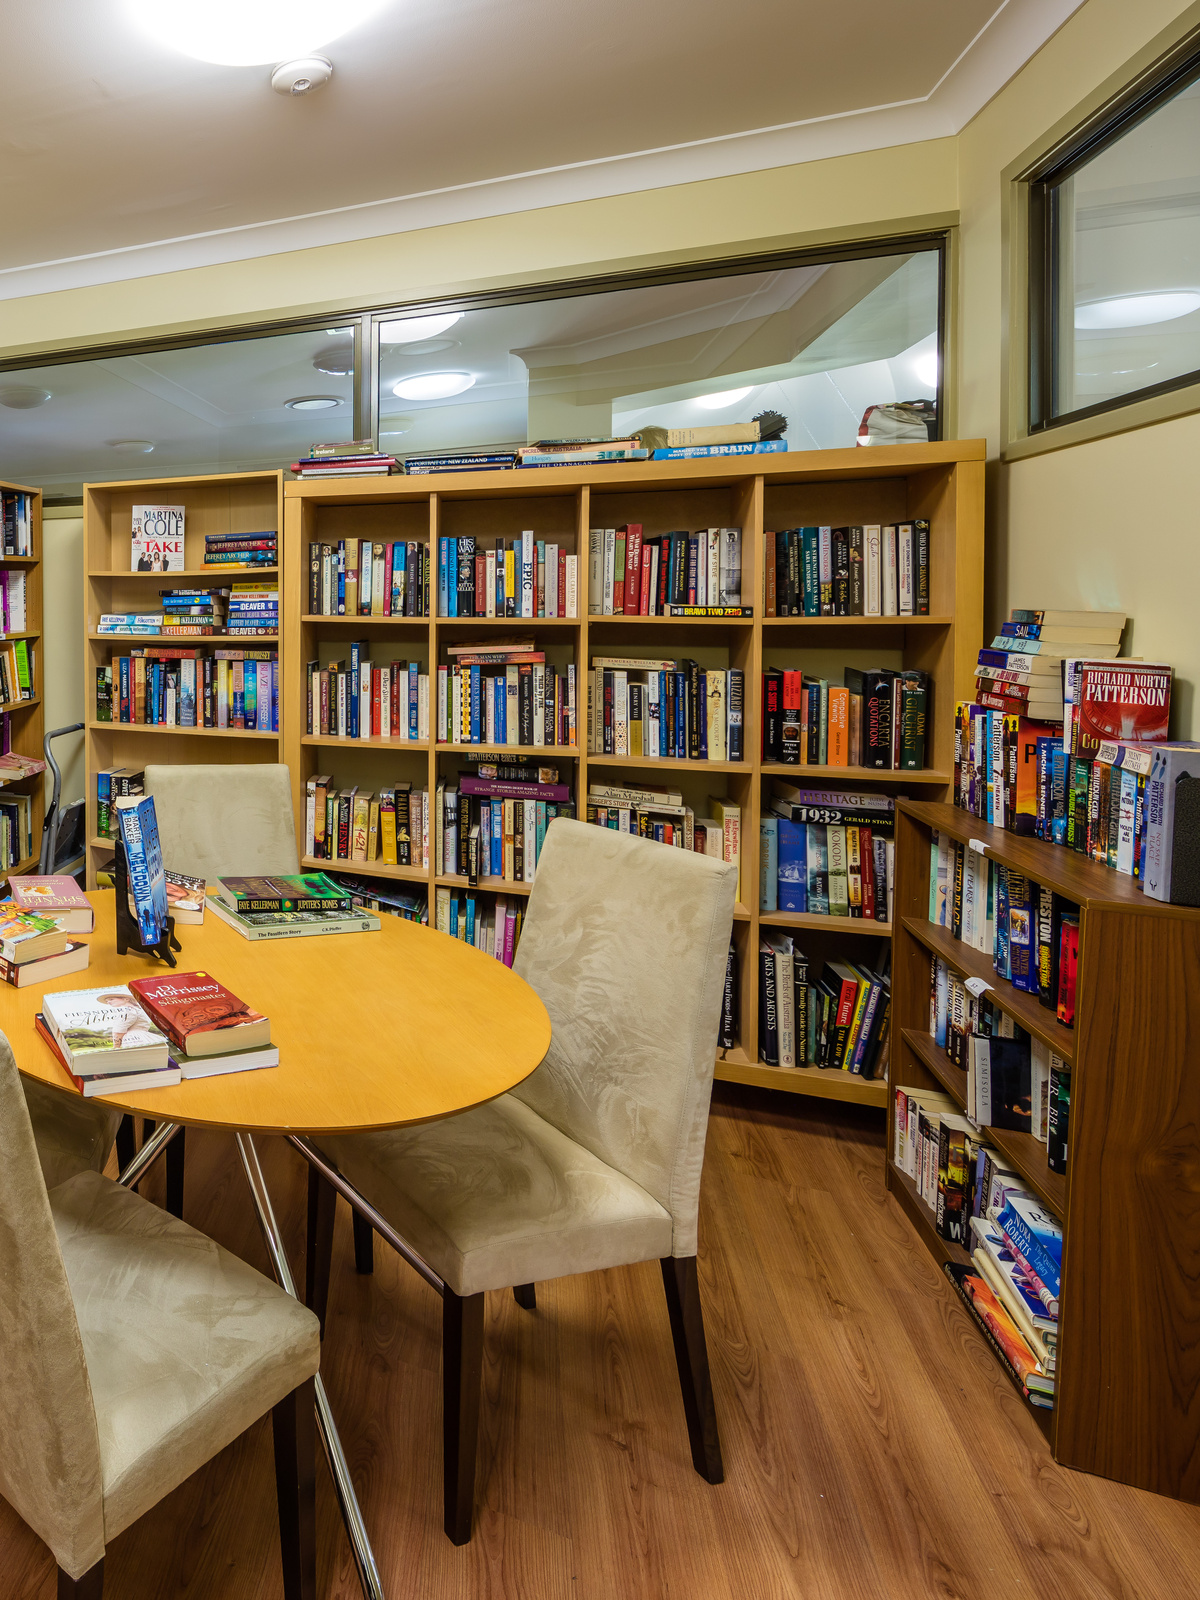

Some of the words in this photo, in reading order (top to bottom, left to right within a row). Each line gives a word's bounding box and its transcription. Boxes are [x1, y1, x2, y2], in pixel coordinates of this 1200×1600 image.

[710, 443, 753, 455] BRAIN
[144, 511, 183, 521] MARTINA
[144, 520, 183, 536] COLE
[822, 528, 830, 546] SARA
[146, 541, 183, 553] TAKE
[458, 545, 474, 553] WAY
[459, 537, 474, 546] HIS
[822, 548, 830, 579] HENDERSON
[523, 562, 532, 590] EPIC
[241, 602, 265, 610] DEAVER
[183, 616, 214, 624] KELLERMAN
[166, 627, 201, 635] KELLERMAN
[1015, 625, 1028, 637] SAIL
[1008, 662, 1029, 670] PATTERSON
[768, 681, 777, 693] BIG
[1087, 671, 1131, 685] RICHARD
[1134, 674, 1167, 688] NORTH
[730, 676, 742, 711] BLIZZARD
[1085, 685, 1166, 706] PATTERSON
[768, 695, 777, 712] SHOTS
[831, 698, 840, 723] Viewing
[838, 693, 846, 728] Compulsive
[868, 697, 879, 747] QUOTATIONS
[879, 699, 890, 746] ENCARTA
[904, 697, 918, 751] GILCHRIST
[916, 712, 925, 735] ADAM
[801, 792, 865, 805] HERITAGE
[1150, 780, 1158, 824] PATTERSON
[800, 808, 841, 824] 1932
[1135, 796, 1143, 834] Patterson
[124, 817, 135, 844] BAKER
[131, 816, 141, 843] MARTIN
[831, 830, 842, 867] KOKODA
[130, 852, 151, 902] MELTDOWN
[239, 901, 250, 909] FAYE
[251, 900, 280, 909] KELLERMAN
[297, 899, 321, 911] JUPITER'S
[322, 899, 338, 909] BONES
[765, 956, 773, 972] ARTS
[782, 959, 790, 971] The
[766, 975, 775, 996] AND
[782, 973, 791, 990] Birds
[144, 983, 220, 1000] Morrissey
[158, 992, 226, 1007] Songmaster
[867, 986, 880, 1012] SPIDERS
[767, 999, 776, 1030] ARTISTS
[783, 1000, 793, 1030] Australia
[840, 1001, 851, 1024] future
[862, 1018, 870, 1040] WORLD
[980, 1057, 989, 1107] SIMISOLA
[1014, 1211, 1031, 1241] NORA
[1005, 1218, 1032, 1257] ROBERTS
